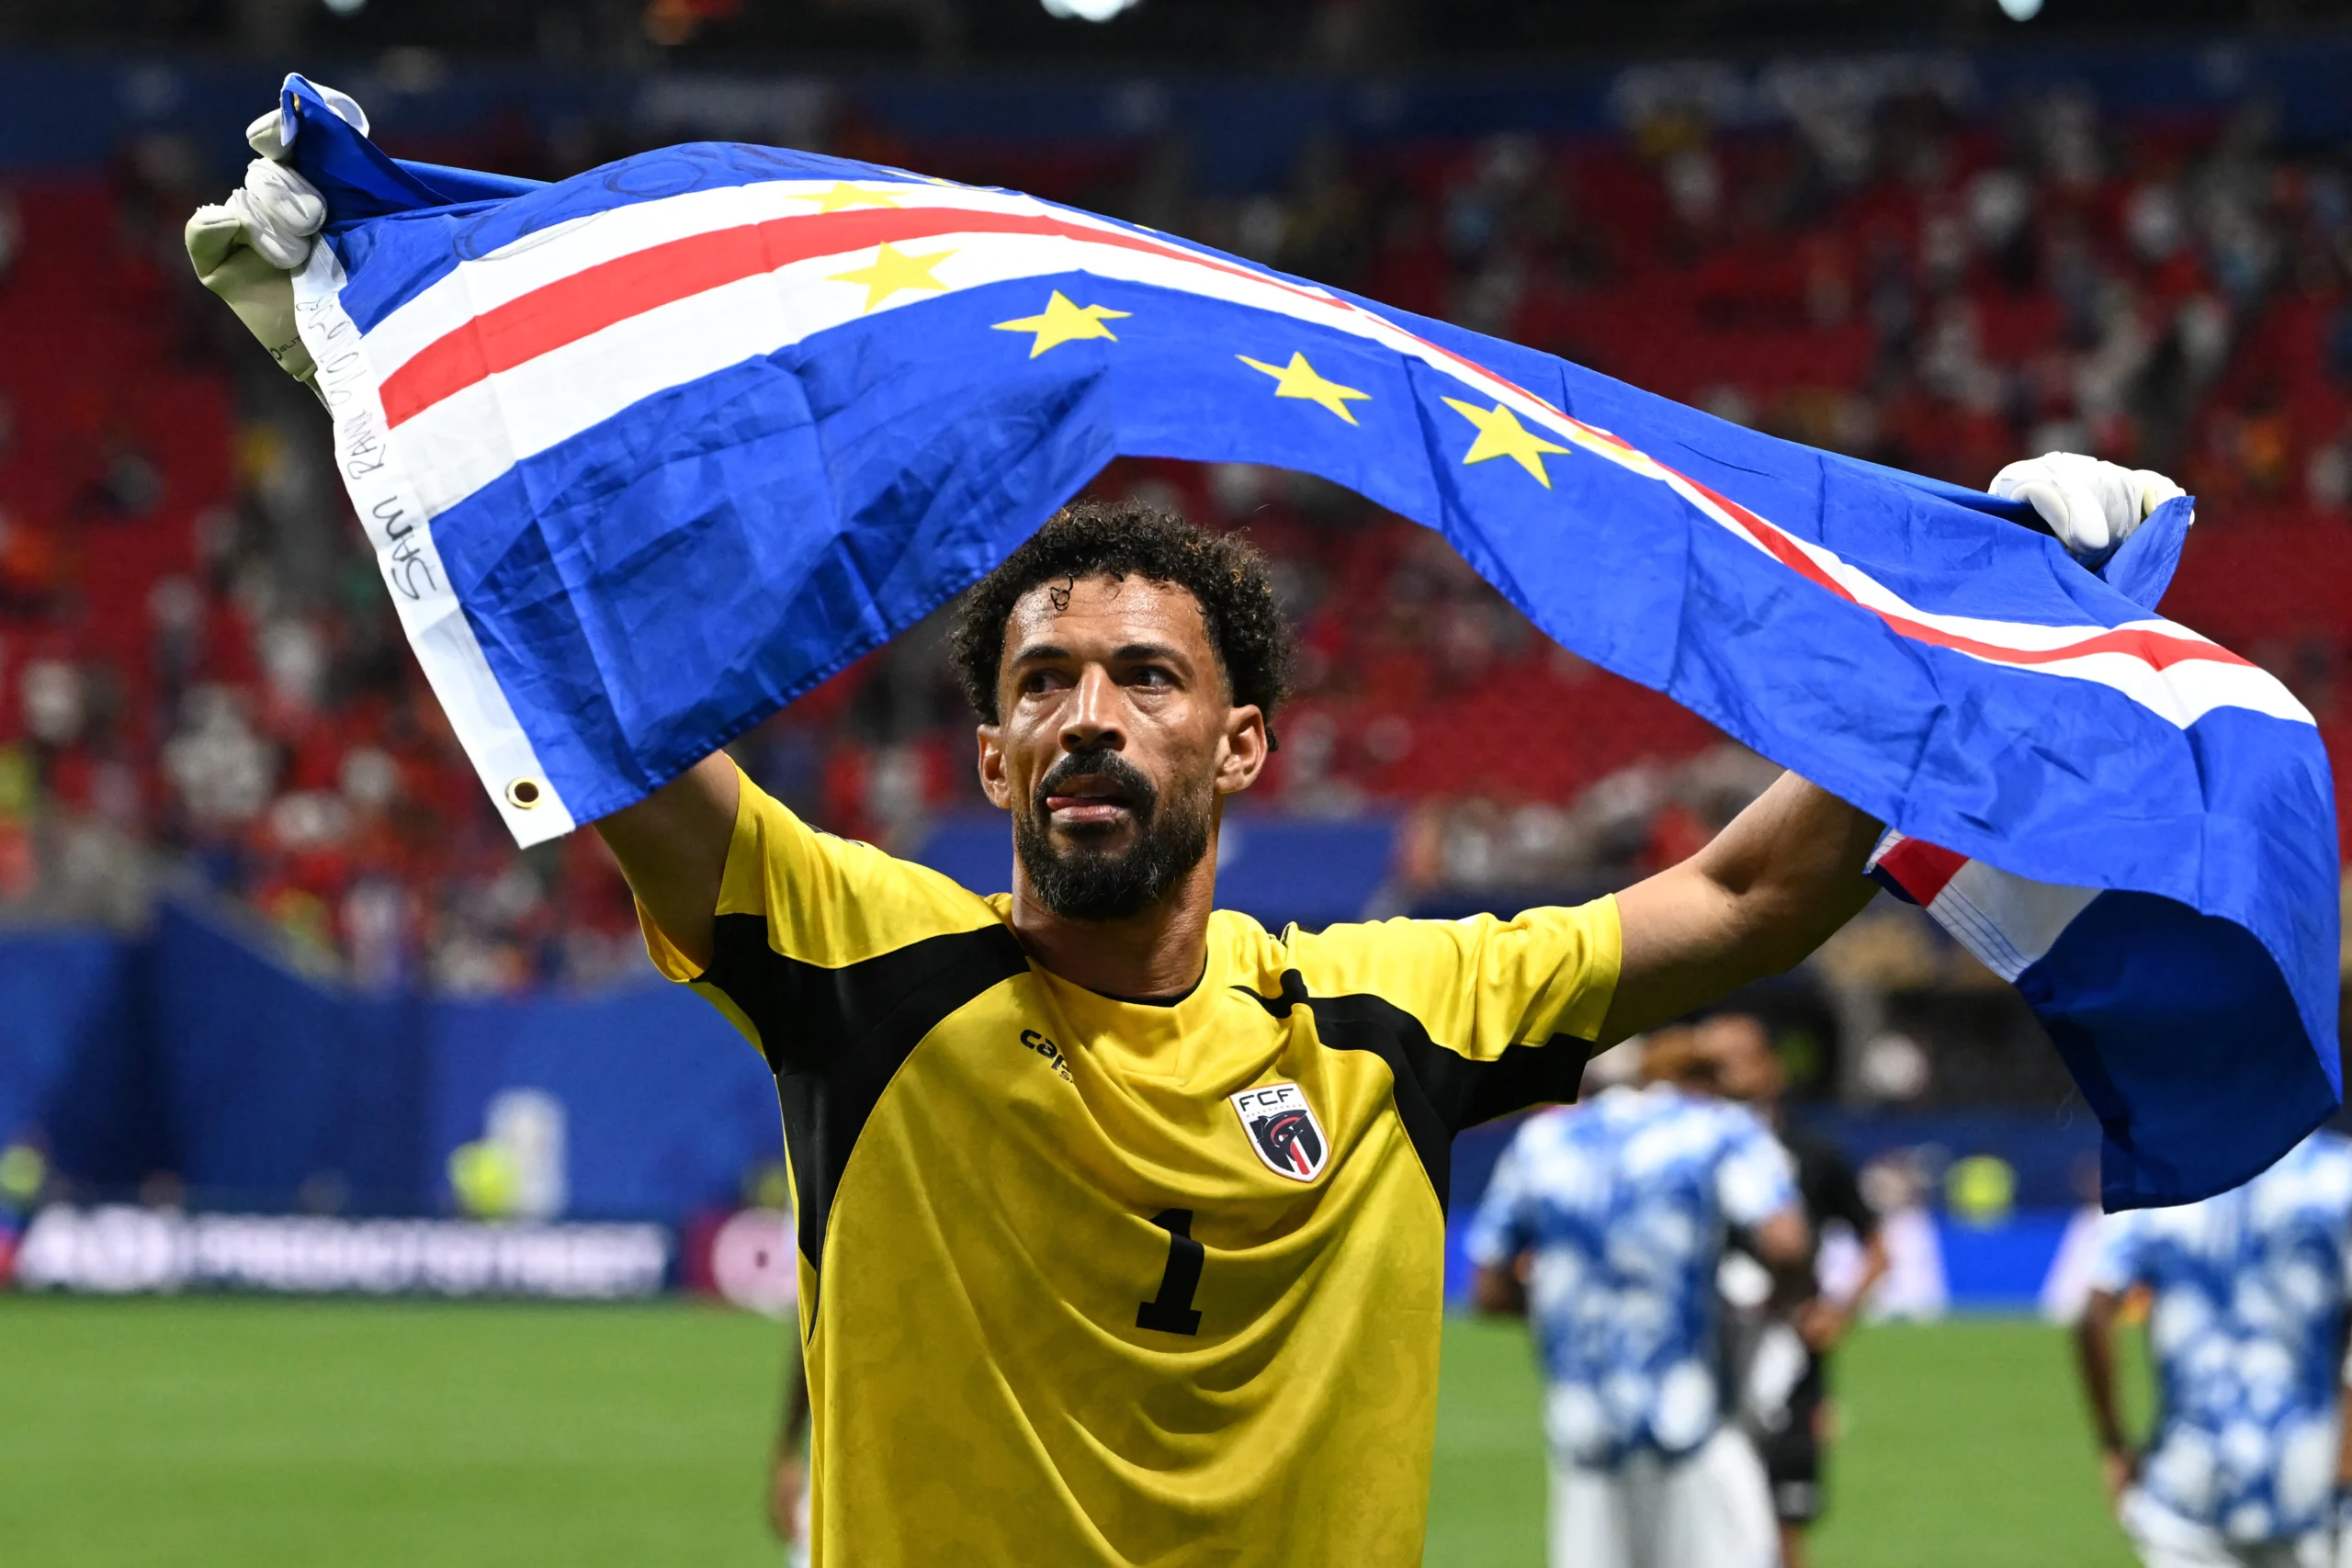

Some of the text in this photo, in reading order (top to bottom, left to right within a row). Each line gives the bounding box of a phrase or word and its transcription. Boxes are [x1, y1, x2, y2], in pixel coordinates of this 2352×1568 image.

[372, 495, 437, 600] SAM
[1238, 1088, 1294, 1111] FCF
[1136, 1207, 1204, 1336] 1
